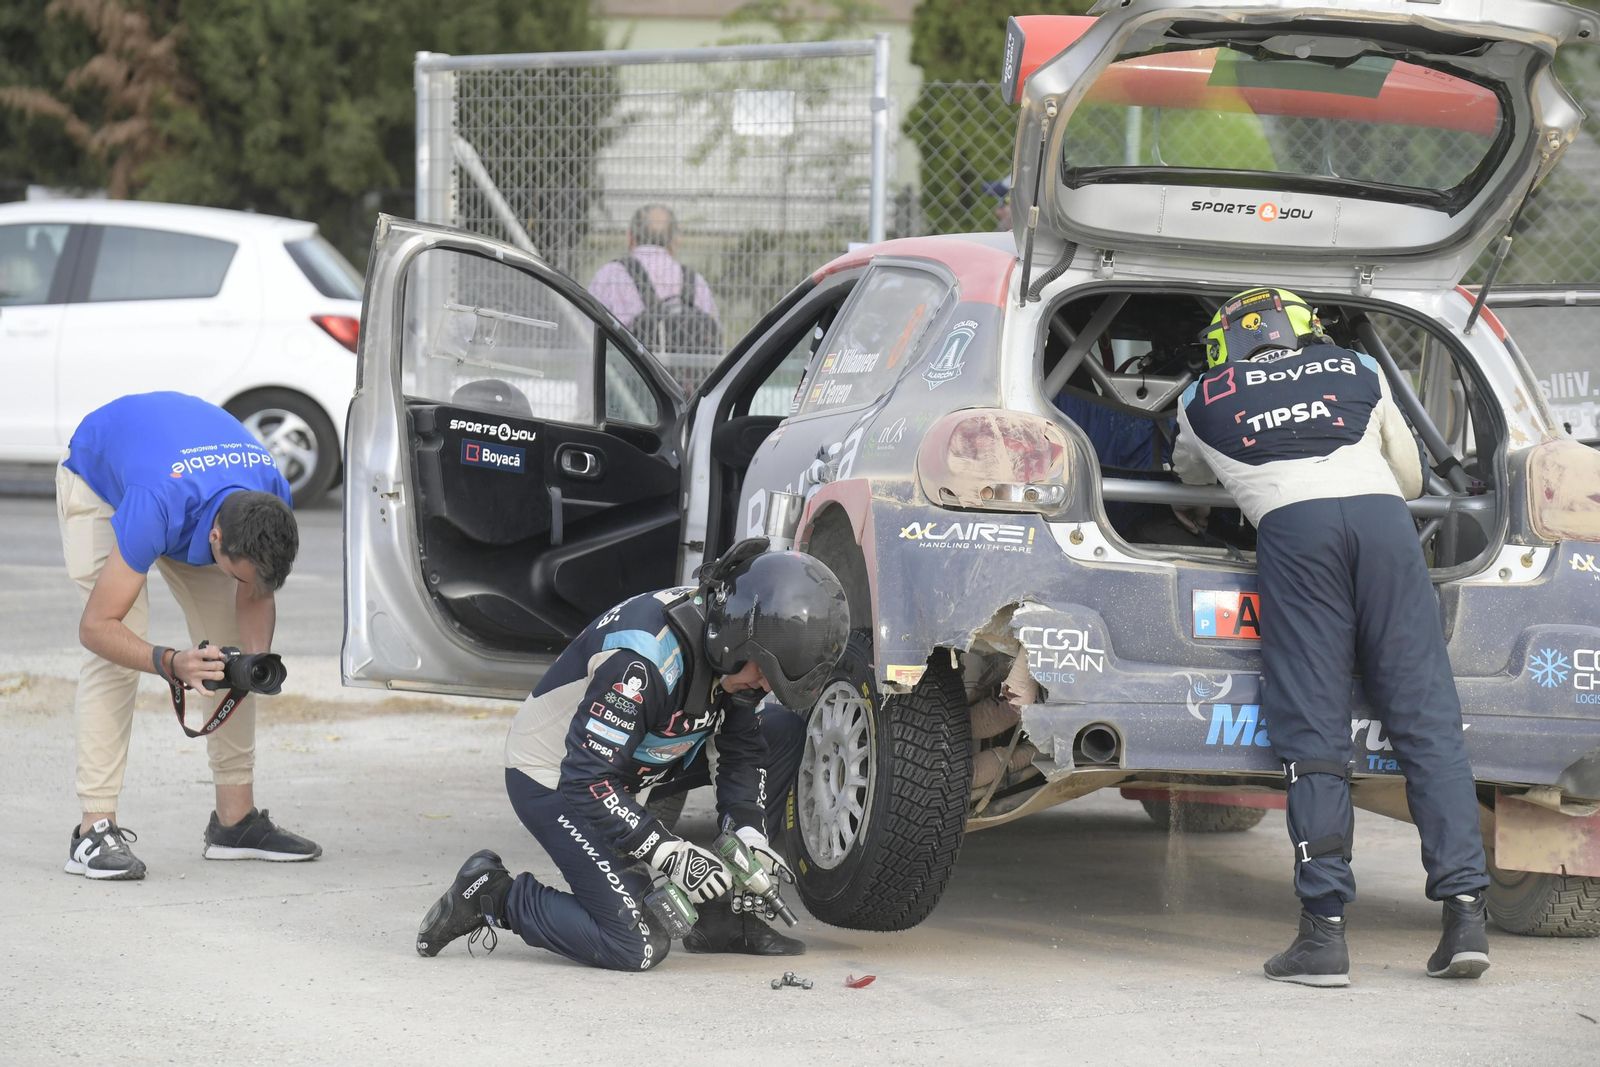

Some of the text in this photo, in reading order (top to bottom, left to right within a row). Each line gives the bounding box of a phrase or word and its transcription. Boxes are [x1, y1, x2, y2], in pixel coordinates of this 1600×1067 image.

[1246, 400, 1332, 433] TIPSA
[1003, 545, 1033, 554] CARE
[1201, 620, 1209, 629] P
[1233, 597, 1260, 635] A
[1020, 627, 1105, 654] COOL
[218, 698, 236, 720] EOS
[588, 739, 614, 758] TIPSA
[1366, 754, 1402, 771] Tra
